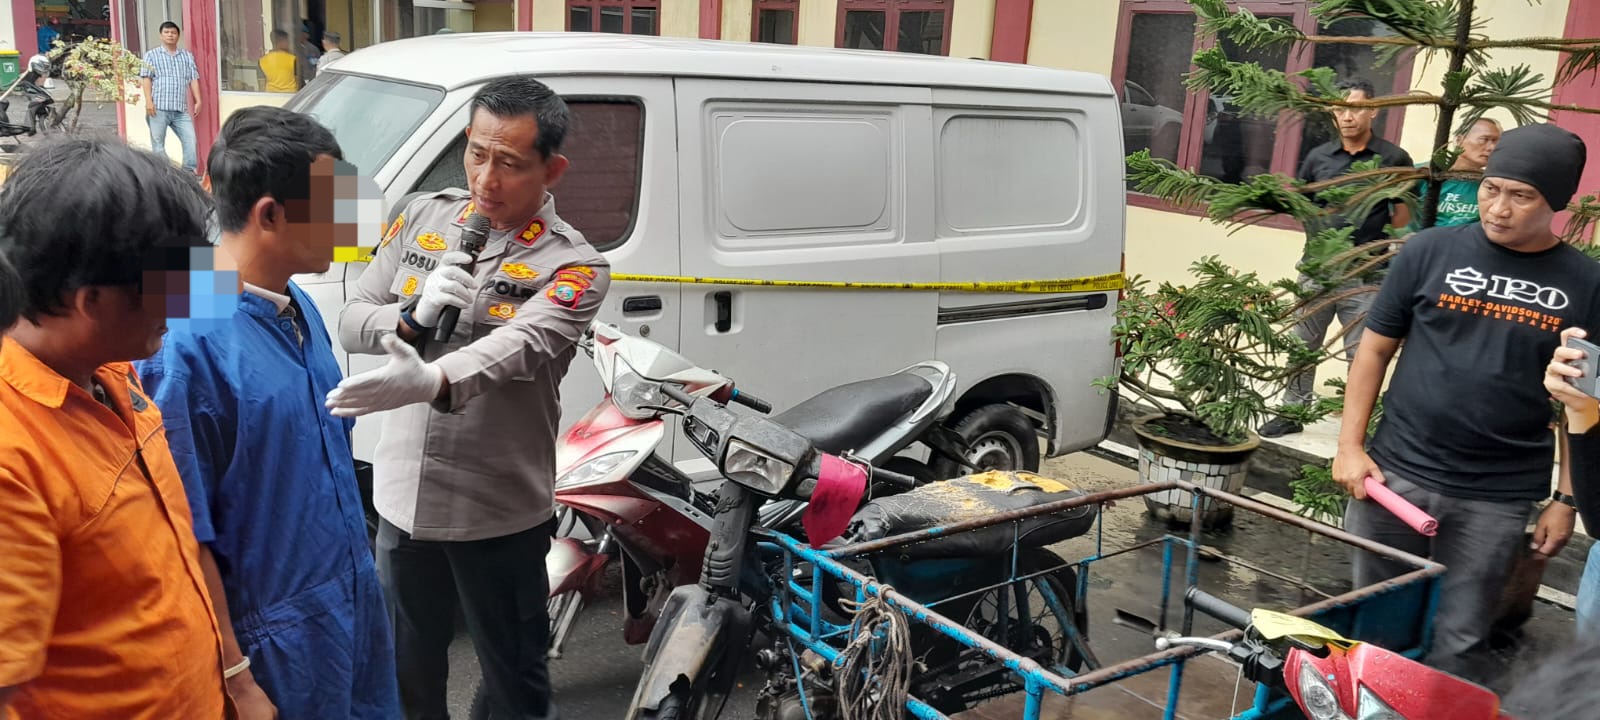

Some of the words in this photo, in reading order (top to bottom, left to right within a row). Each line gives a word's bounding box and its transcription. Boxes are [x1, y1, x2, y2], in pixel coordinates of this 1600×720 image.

[1437, 201, 1479, 214] URSELF
[1444, 192, 1461, 202] BE
[402, 250, 438, 271] JOSU
[1487, 274, 1569, 310] 120
[1436, 301, 1559, 333] ANNIVERSARY
[1439, 293, 1541, 320] HARLEY-DAVIDSON
